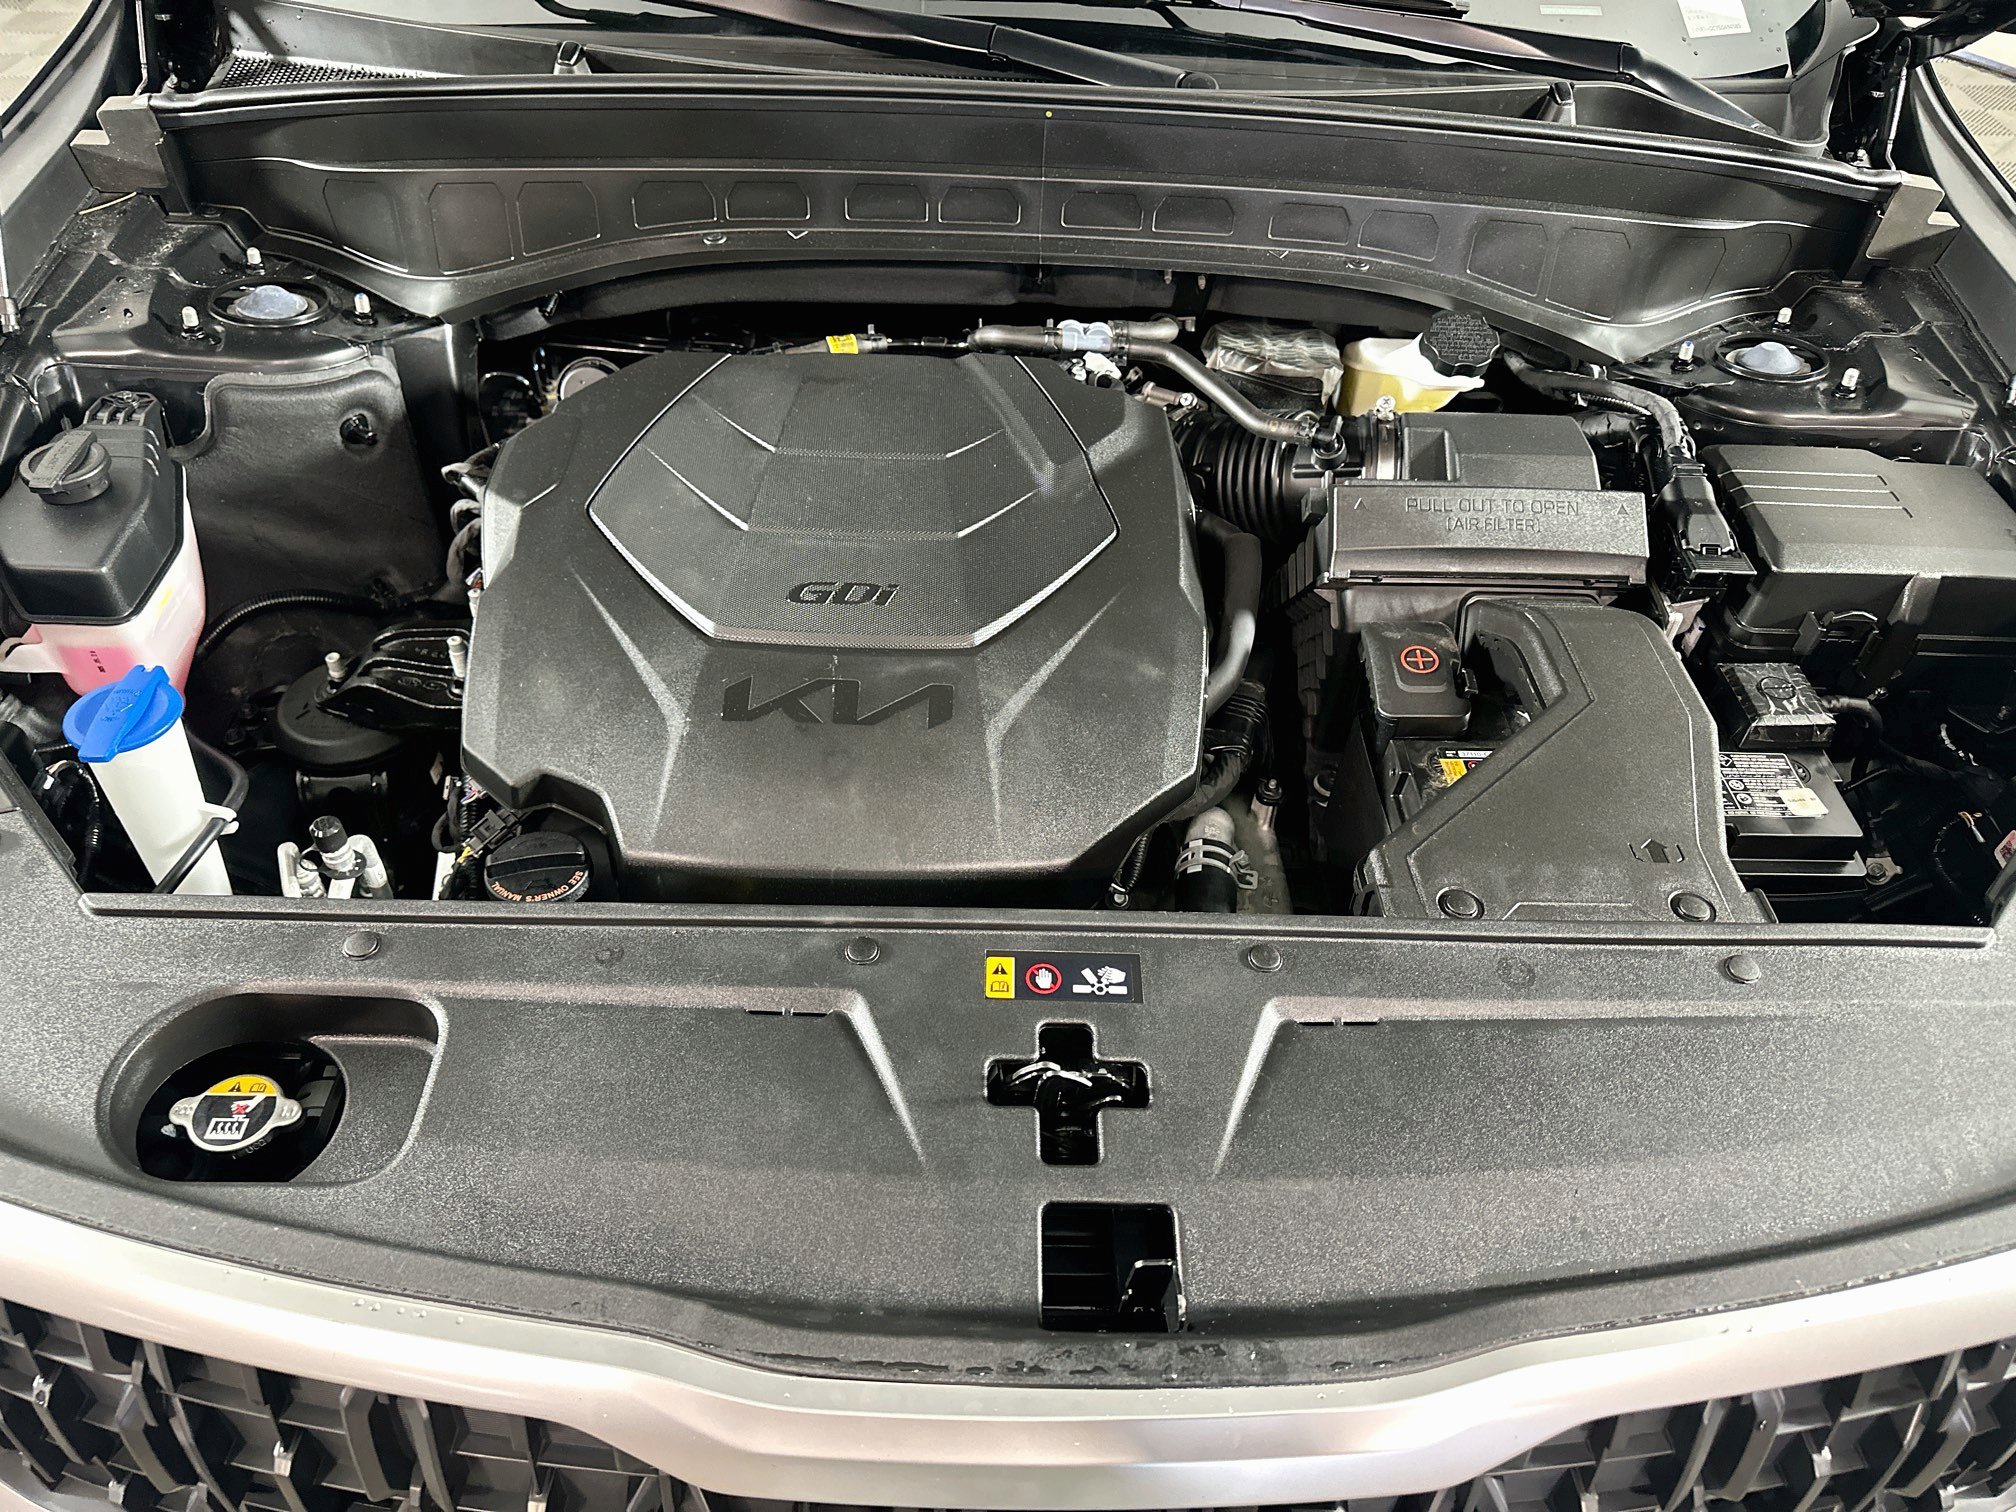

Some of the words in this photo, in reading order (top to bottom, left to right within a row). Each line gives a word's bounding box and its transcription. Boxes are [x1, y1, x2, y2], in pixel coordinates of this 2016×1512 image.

[1405, 497, 1453, 513] PULL
[1458, 498, 1496, 514] OUT
[1501, 499, 1525, 514] TO
[1530, 500, 1580, 516] OPEN
[722, 676, 954, 729] KIA
[568, 870, 584, 886] SEE
[491, 881, 522, 902] MANUAL
[525, 884, 569, 902] OWNER'S
